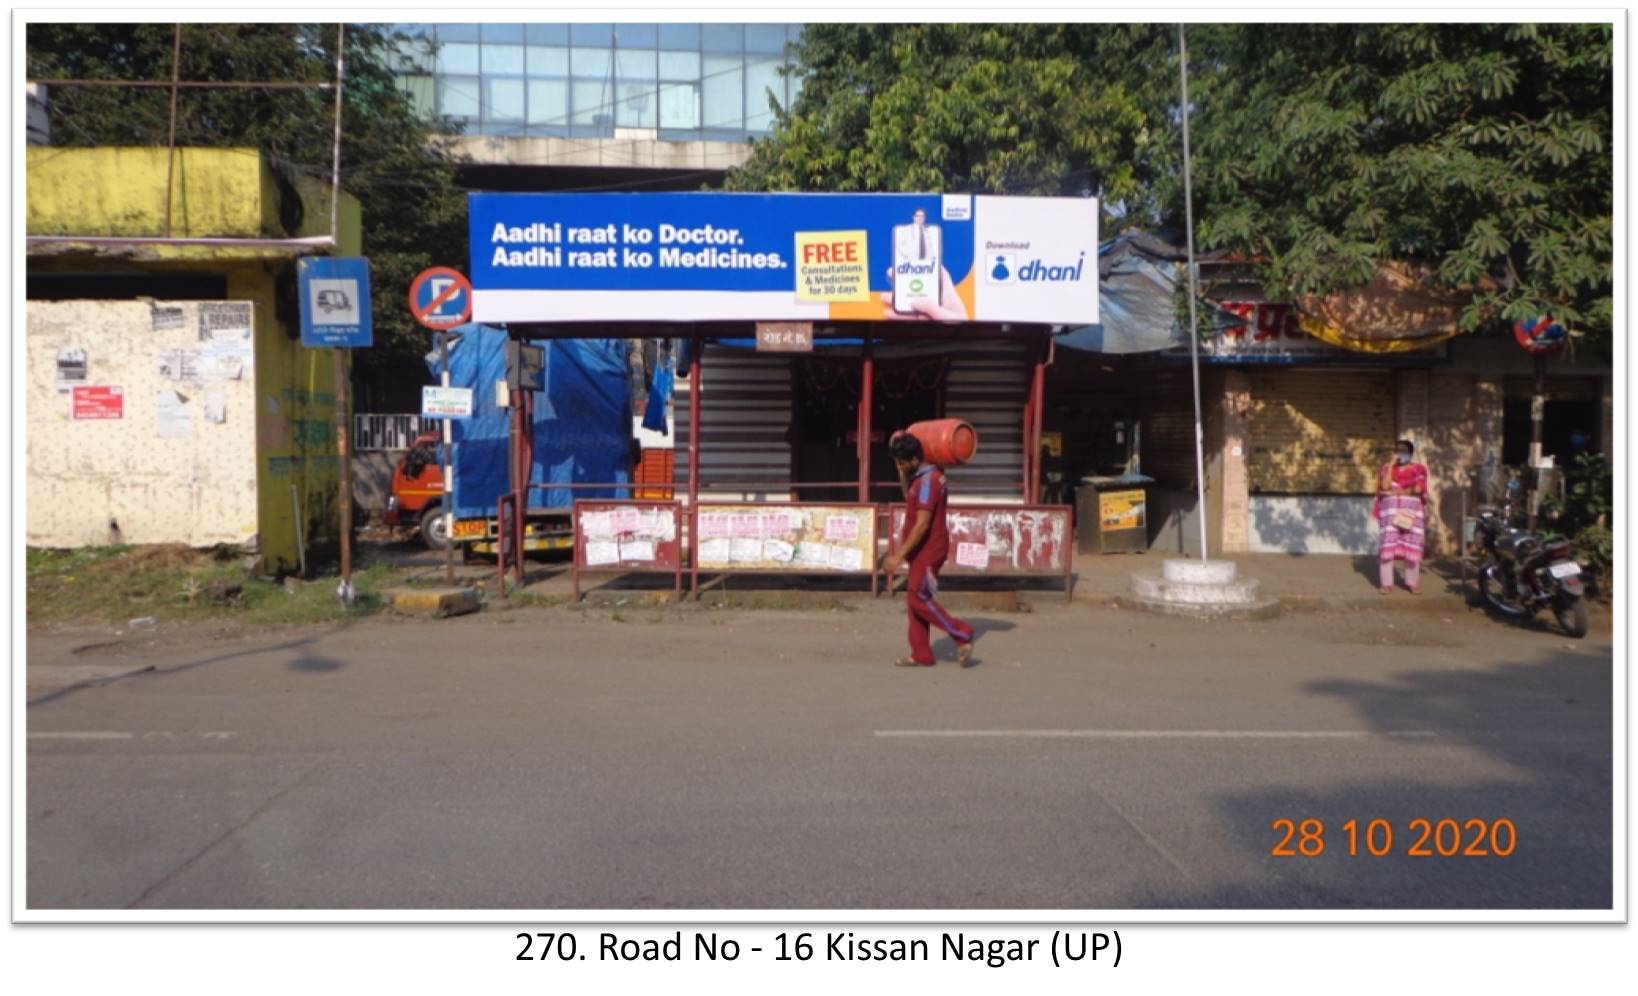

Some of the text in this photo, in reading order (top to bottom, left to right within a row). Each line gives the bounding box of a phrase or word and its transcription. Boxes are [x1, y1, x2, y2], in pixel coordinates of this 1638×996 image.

[491, 222, 744, 245] Aadhi raat ko Doctor.
[803, 241, 859, 264] FREE
[985, 240, 1031, 250] Download
[491, 246, 787, 269] Aadhi raat ko Medicines.
[897, 256, 937, 275] dhani
[1018, 250, 1086, 282] dhani
[801, 265, 863, 275] Consultations
[805, 274, 860, 285] & Medicines
[431, 278, 461, 314] P
[809, 284, 858, 295] for 30 days
